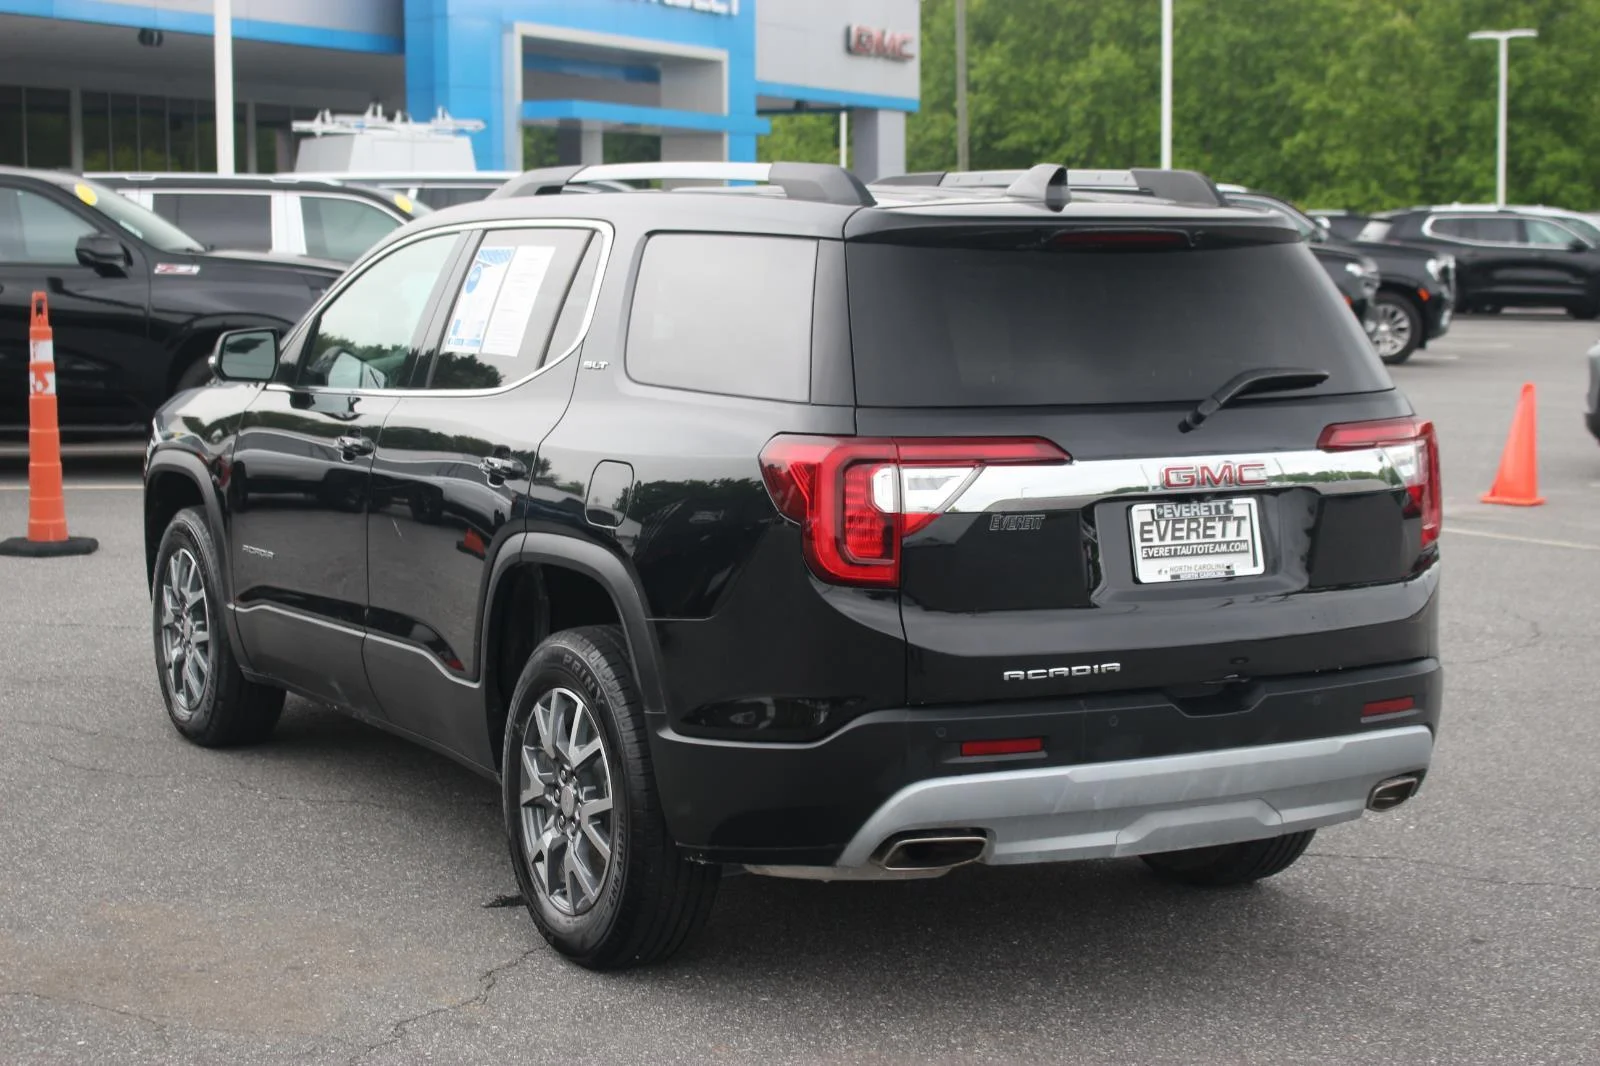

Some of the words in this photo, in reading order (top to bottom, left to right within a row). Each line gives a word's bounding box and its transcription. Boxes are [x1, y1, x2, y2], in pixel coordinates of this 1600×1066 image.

[583, 360, 609, 370] SLT
[1162, 463, 1267, 488] GMC
[1163, 501, 1226, 518] EVERETT
[989, 513, 1046, 531] EVERETT
[1140, 515, 1247, 543] EVERETT
[1142, 542, 1248, 558] EVERETTAUTOTEAM.COM
[1169, 564, 1192, 573] NORTH
[562, 653, 605, 704] PRINX
[1003, 662, 1121, 681] ACADIA
